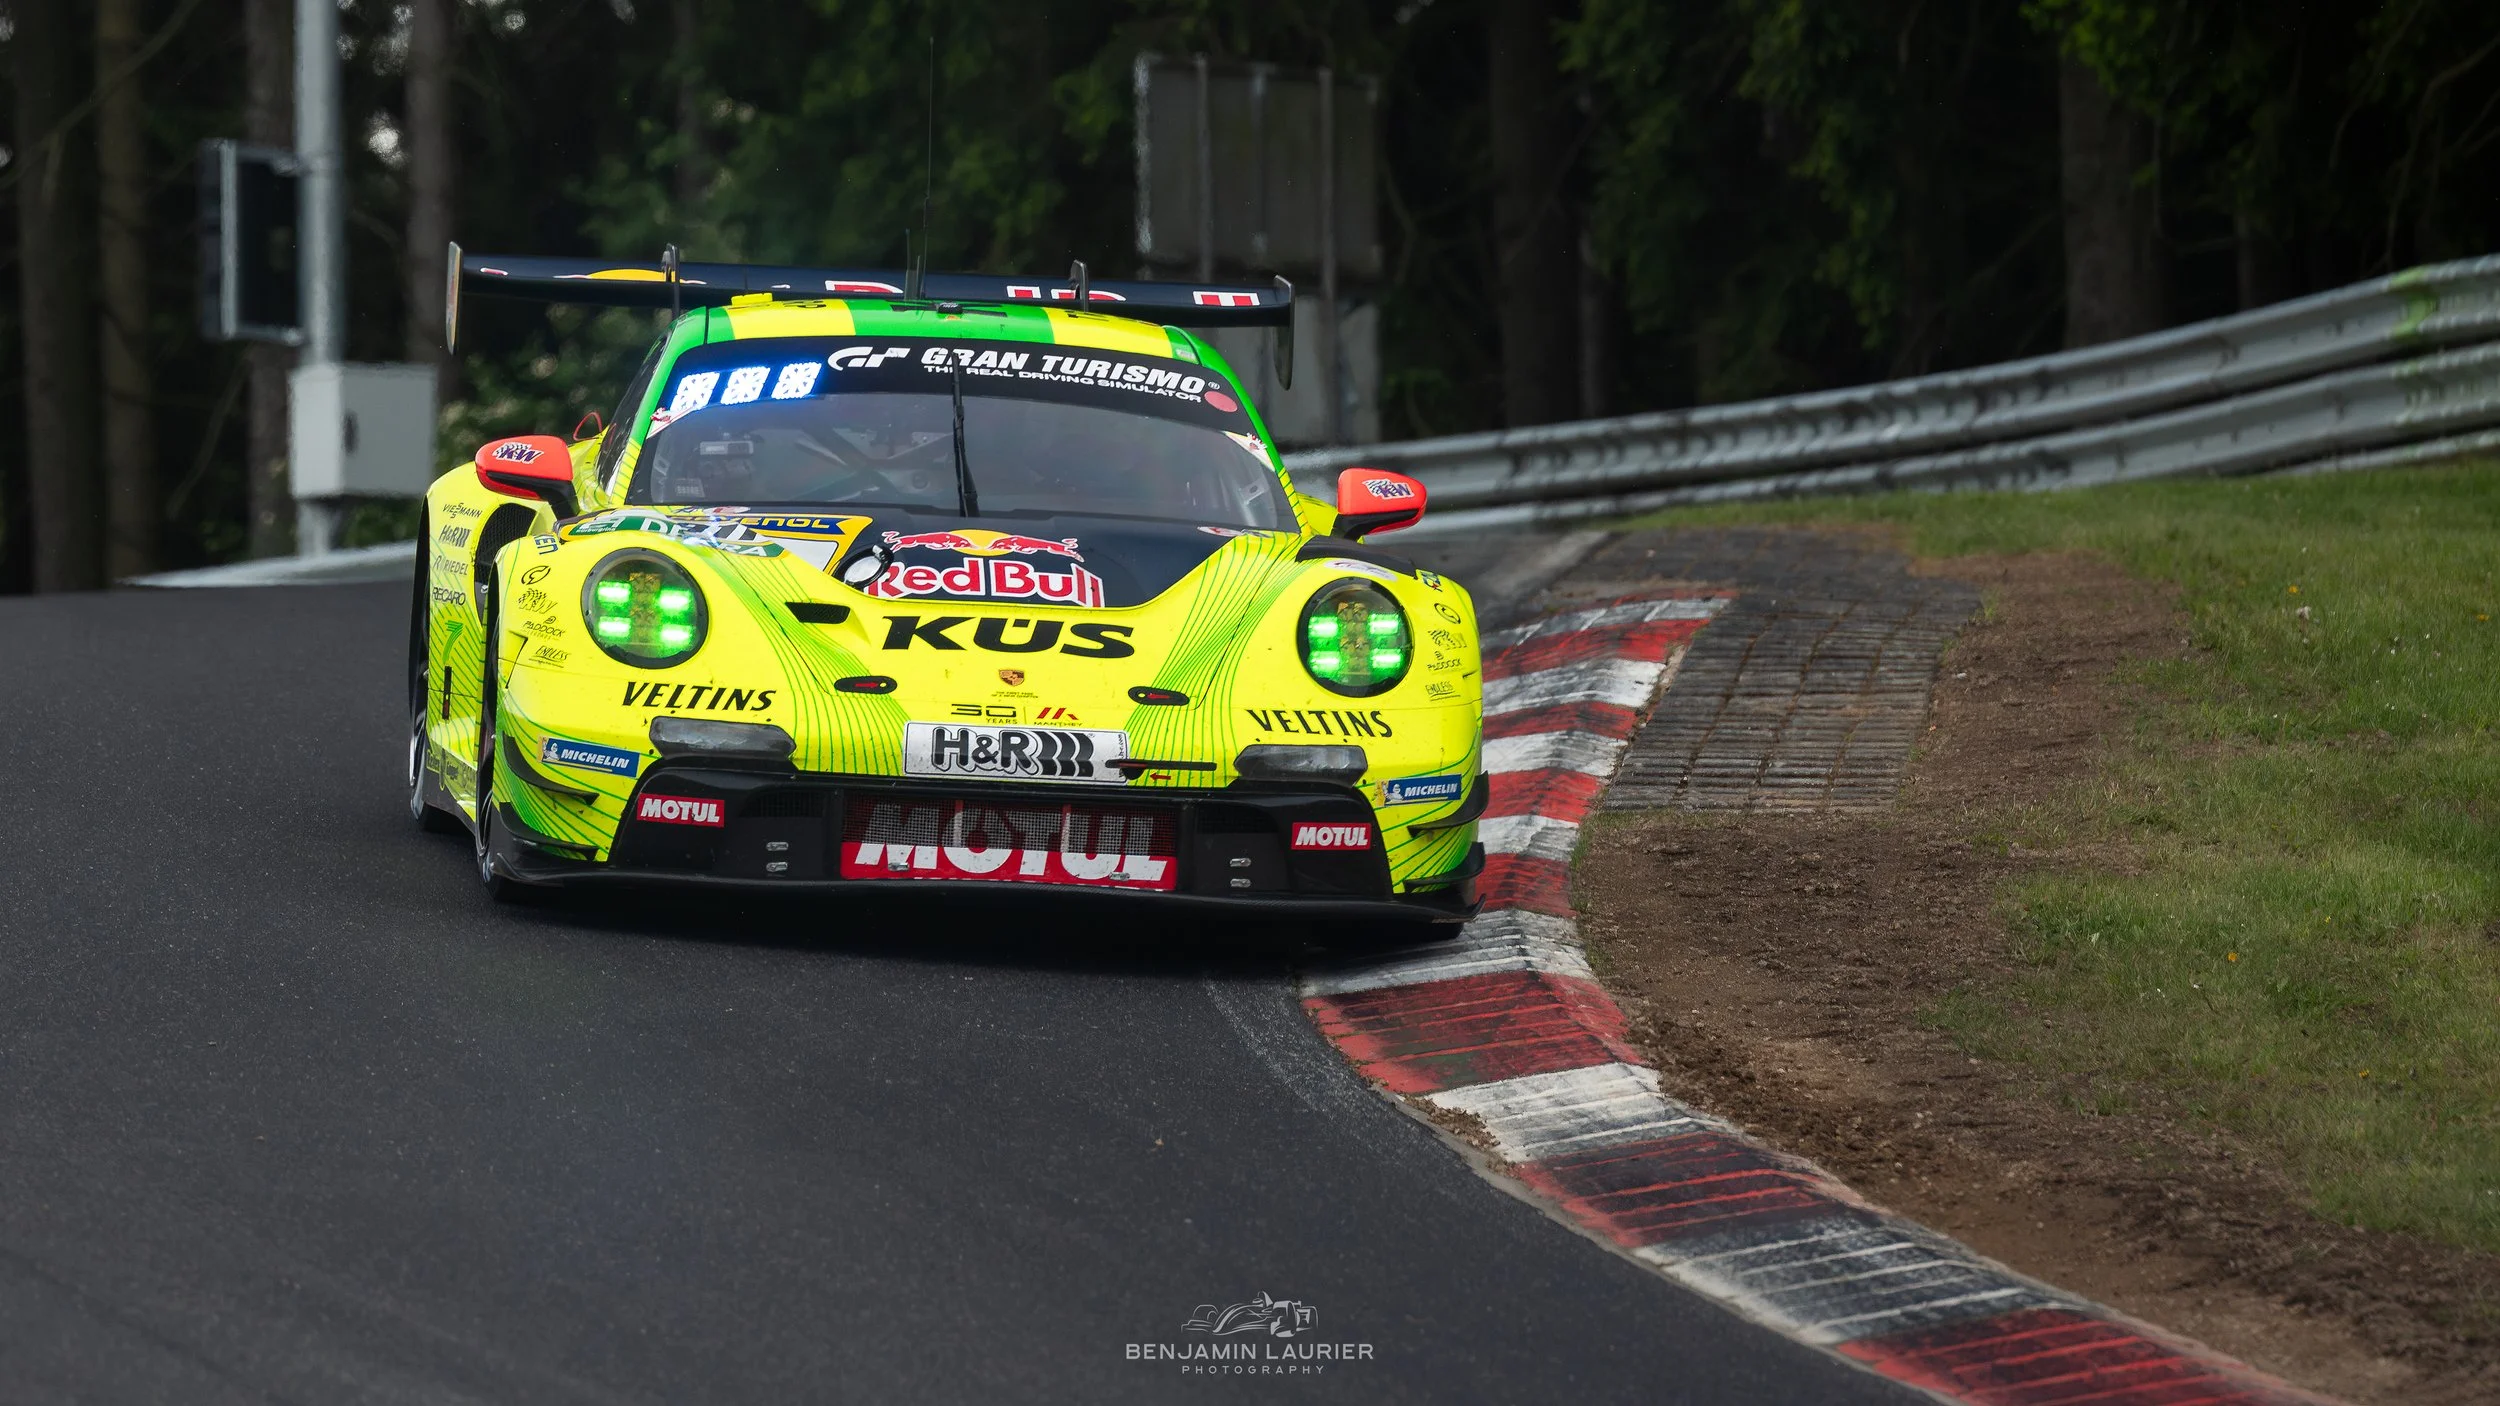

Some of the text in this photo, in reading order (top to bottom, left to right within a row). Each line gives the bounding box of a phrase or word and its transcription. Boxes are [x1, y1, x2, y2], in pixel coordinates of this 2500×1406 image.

[921, 347, 1029, 370] GRAN
[1042, 355, 1206, 394] TURISMO
[966, 368, 1014, 378] REAL
[1018, 371, 1094, 385] DRIVING
[1097, 379, 1202, 403] SIMULATOR
[432, 586, 466, 606] RECARO
[865, 558, 1105, 607] Red Bull
[882, 616, 1135, 659] KÜS
[622, 681, 776, 711] VELTINS
[951, 704, 1016, 718] 30
[1246, 709, 1393, 738] VELTINS
[561, 748, 630, 769] MICHELIN
[932, 728, 1038, 774] H&R
[1404, 783, 1458, 797] MICHELIN
[641, 798, 720, 823] MOTUL
[855, 803, 1168, 882] MOTUL
[1295, 827, 1369, 847] MOTUL
